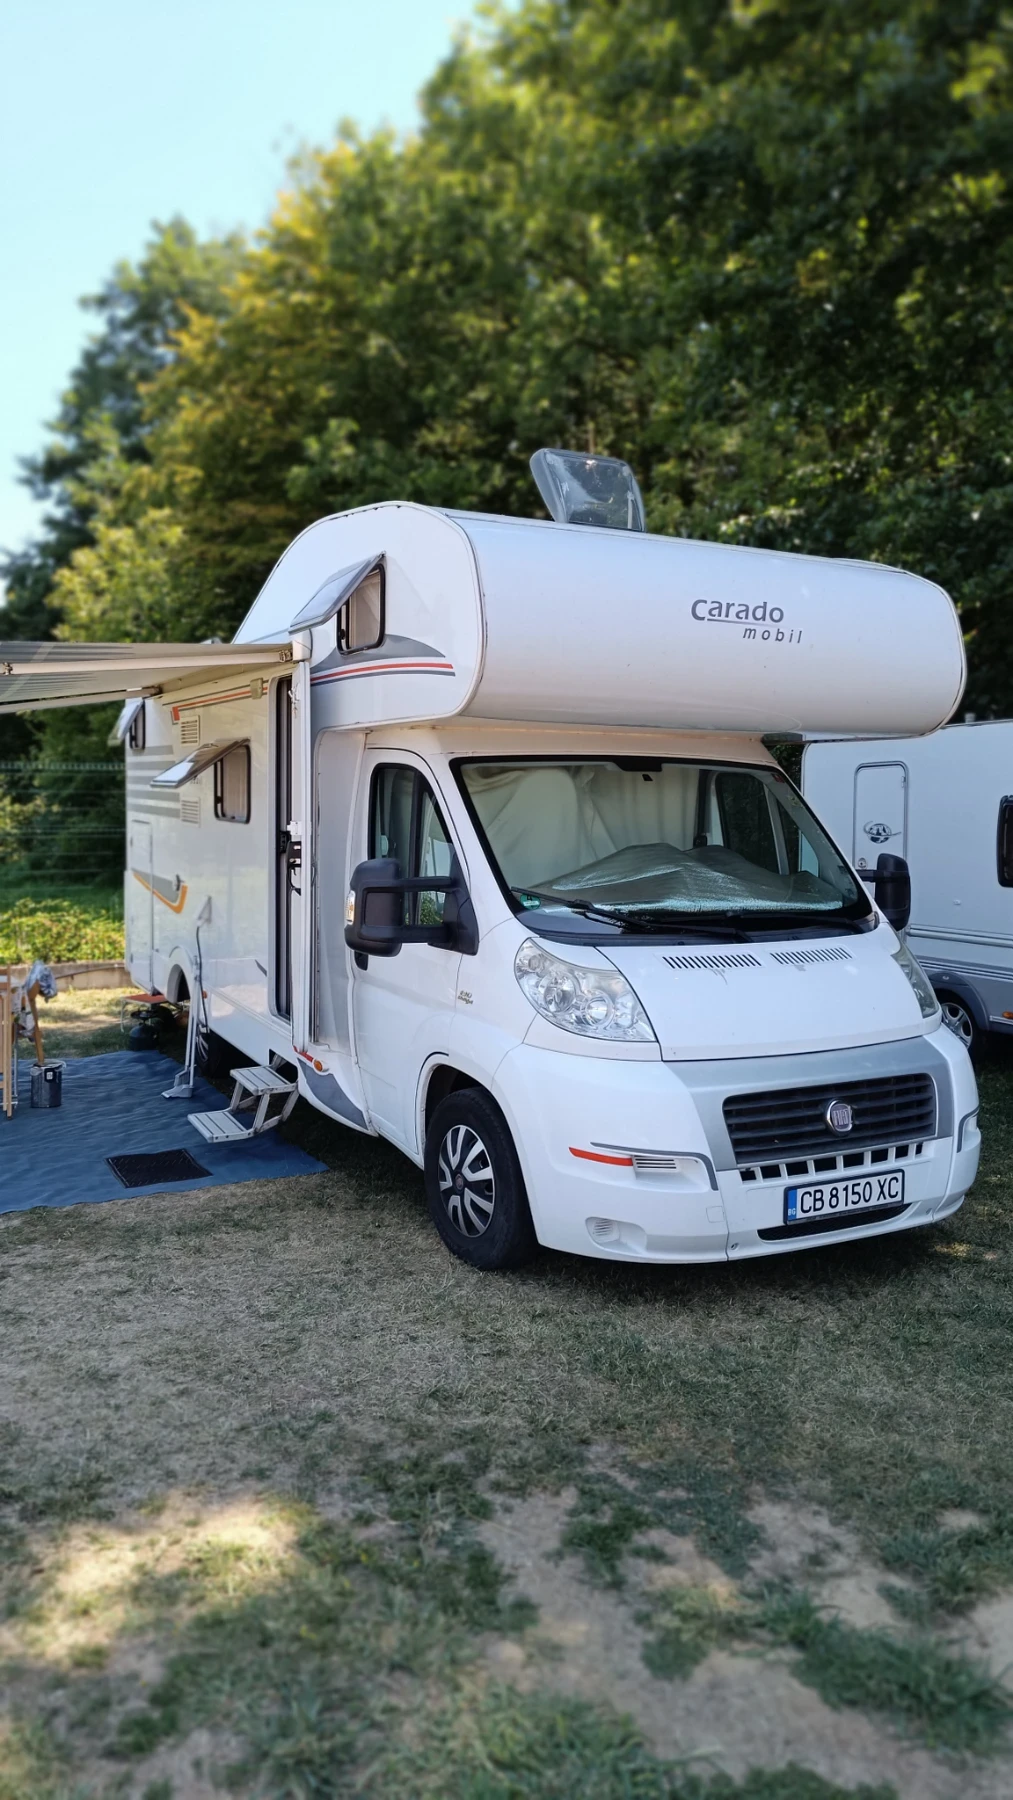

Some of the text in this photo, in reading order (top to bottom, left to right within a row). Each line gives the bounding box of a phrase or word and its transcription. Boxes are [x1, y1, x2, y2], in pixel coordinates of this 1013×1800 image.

[691, 599, 784, 623] Carado
[743, 628, 802, 643] mobil
[800, 1189, 824, 1213] CB
[829, 1181, 872, 1208] 8150
[877, 1177, 899, 1201] XC
[787, 1208, 796, 1216] BG
